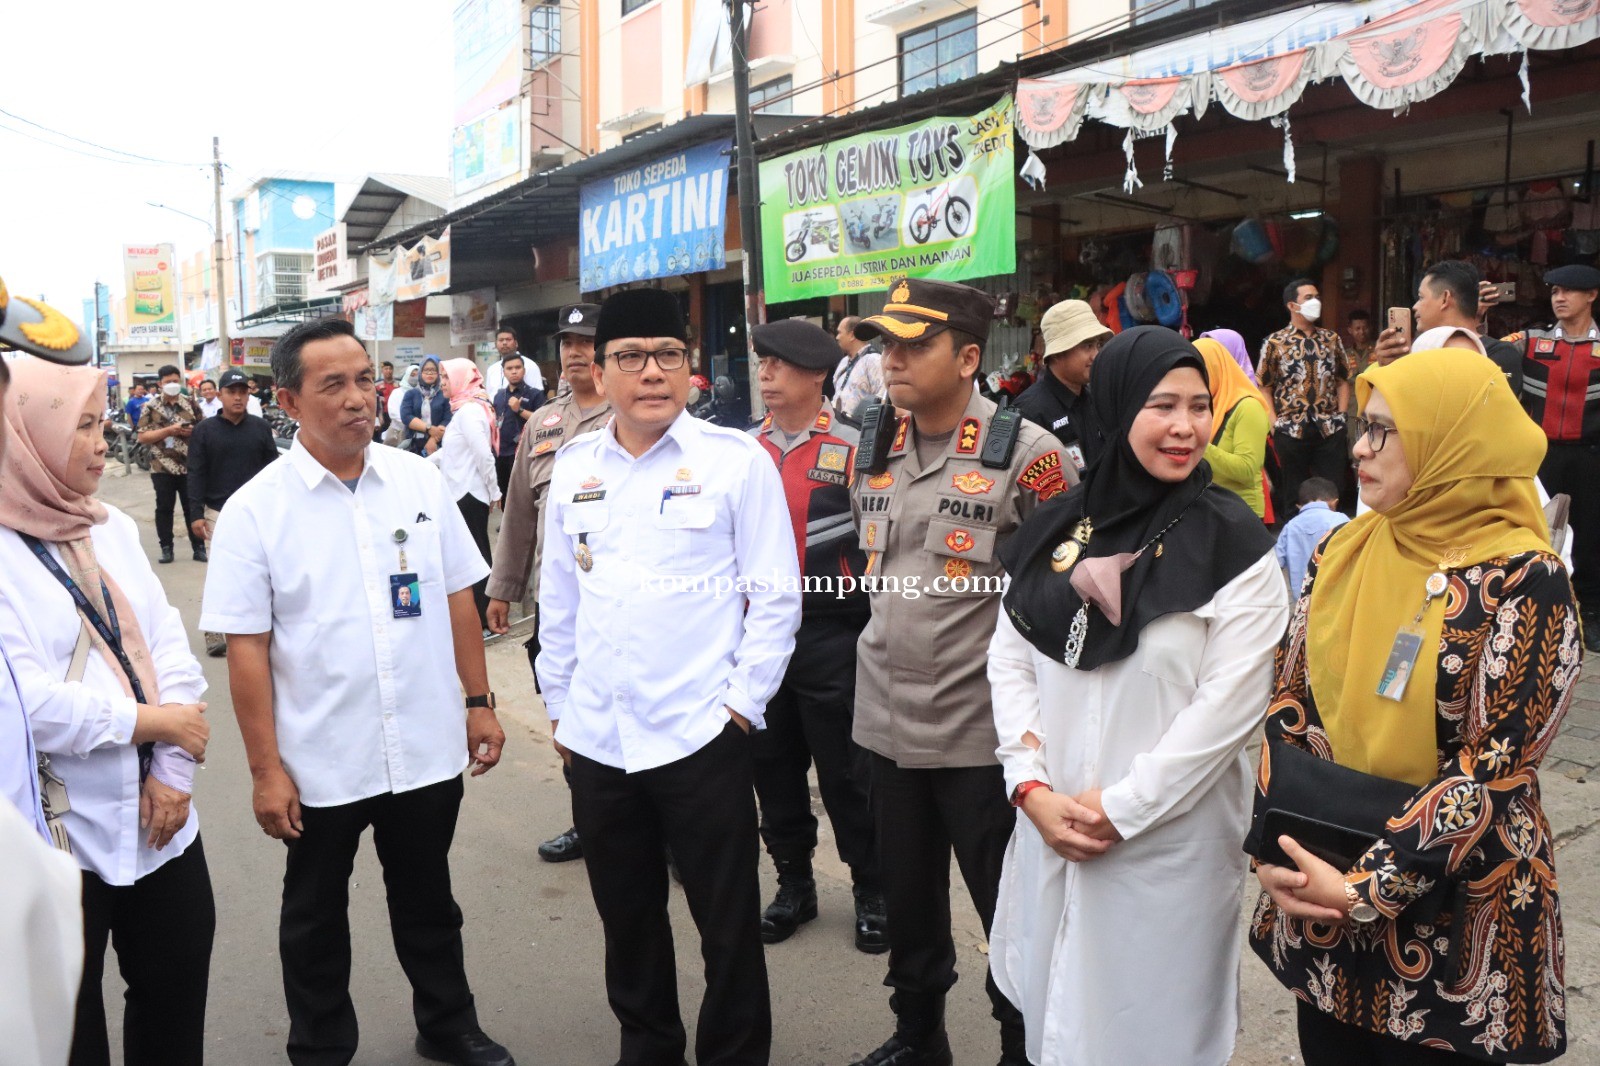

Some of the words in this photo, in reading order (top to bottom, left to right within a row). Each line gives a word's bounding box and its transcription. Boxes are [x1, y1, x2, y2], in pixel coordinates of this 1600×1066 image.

[613, 170, 642, 196] TOKO
[643, 154, 687, 187] SEPEDA
[784, 152, 829, 209] TOKO
[835, 136, 902, 197] GEMINI
[907, 123, 966, 183] TOYS
[582, 168, 724, 257] KARTINI
[316, 232, 337, 252] PASAR
[854, 258, 888, 275] LISTRIK
[891, 255, 917, 270] DAN
[920, 245, 972, 266] MAINAN
[535, 427, 564, 441] HAMID
[1021, 453, 1057, 482] POLRES
[1029, 461, 1058, 484] METRO
[861, 496, 891, 512] HERI
[937, 497, 994, 523] POLRI
